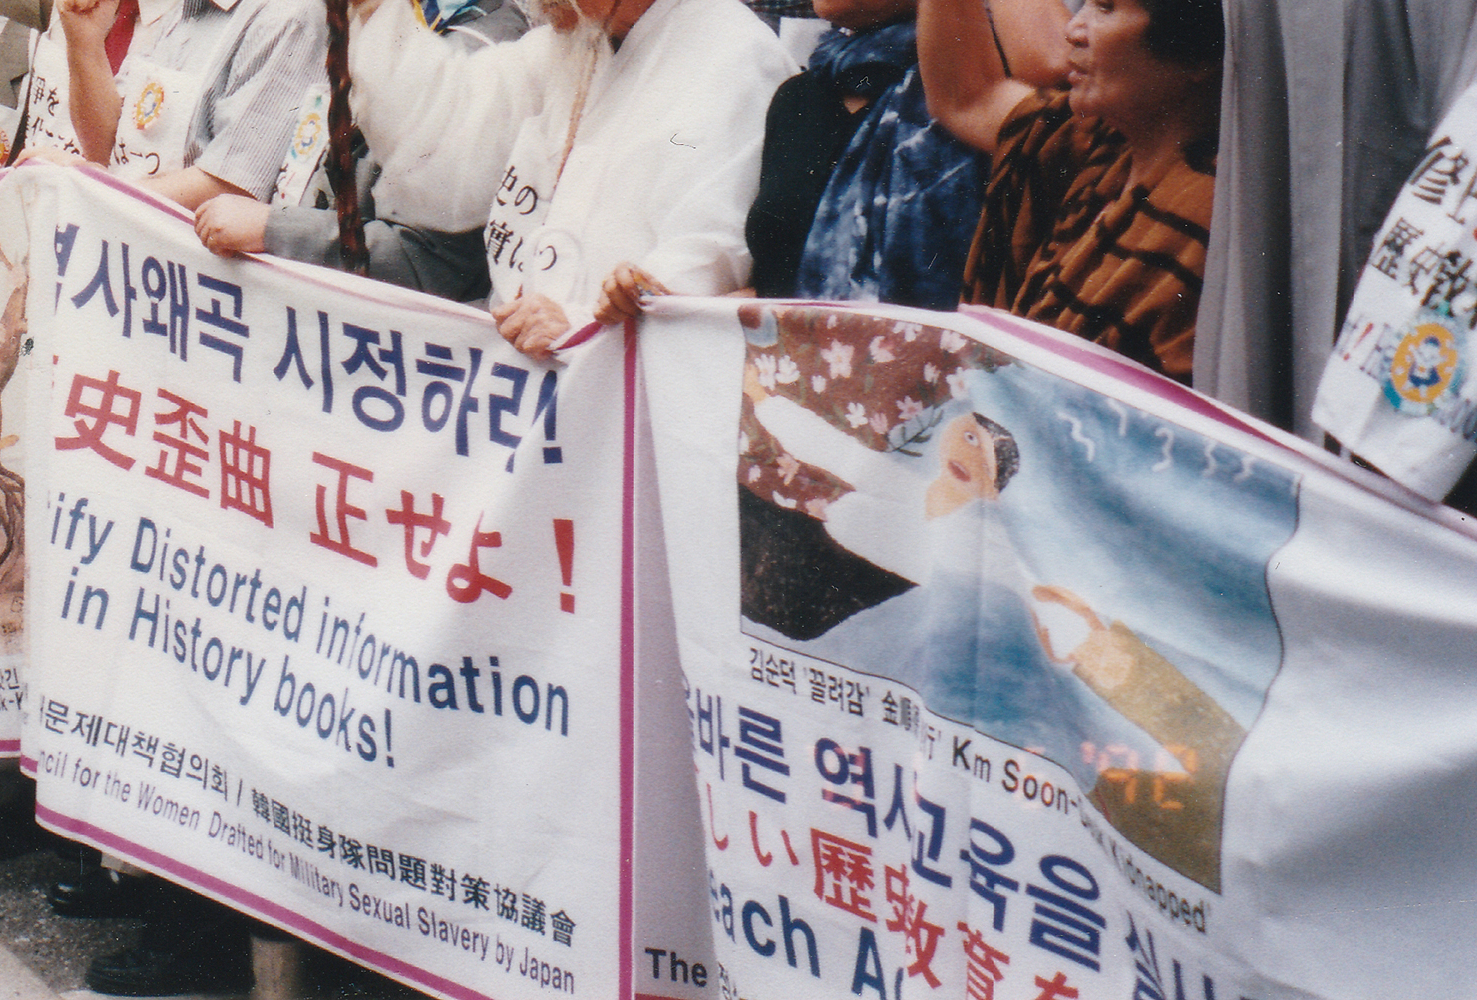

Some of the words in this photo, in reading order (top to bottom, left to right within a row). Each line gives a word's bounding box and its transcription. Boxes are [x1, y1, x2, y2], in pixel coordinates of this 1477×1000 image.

[49, 491, 115, 565] ify
[129, 516, 308, 643] Distorted
[315, 596, 570, 738] information
[60, 566, 110, 630] in
[128, 586, 267, 706] History
[273, 654, 396, 768] books!
[749, 647, 797, 695] 김순덕
[73, 756, 101, 789] for
[104, 770, 131, 802] the
[138, 781, 201, 830] Women
[208, 811, 265, 862] Drafted
[267, 839, 286, 871] for
[288, 851, 345, 908] Military
[348, 883, 412, 931] Sexual
[416, 906, 491, 961] Slavery
[494, 934, 516, 984] by
[520, 947, 576, 995] Japan
[644, 947, 708, 988] The
